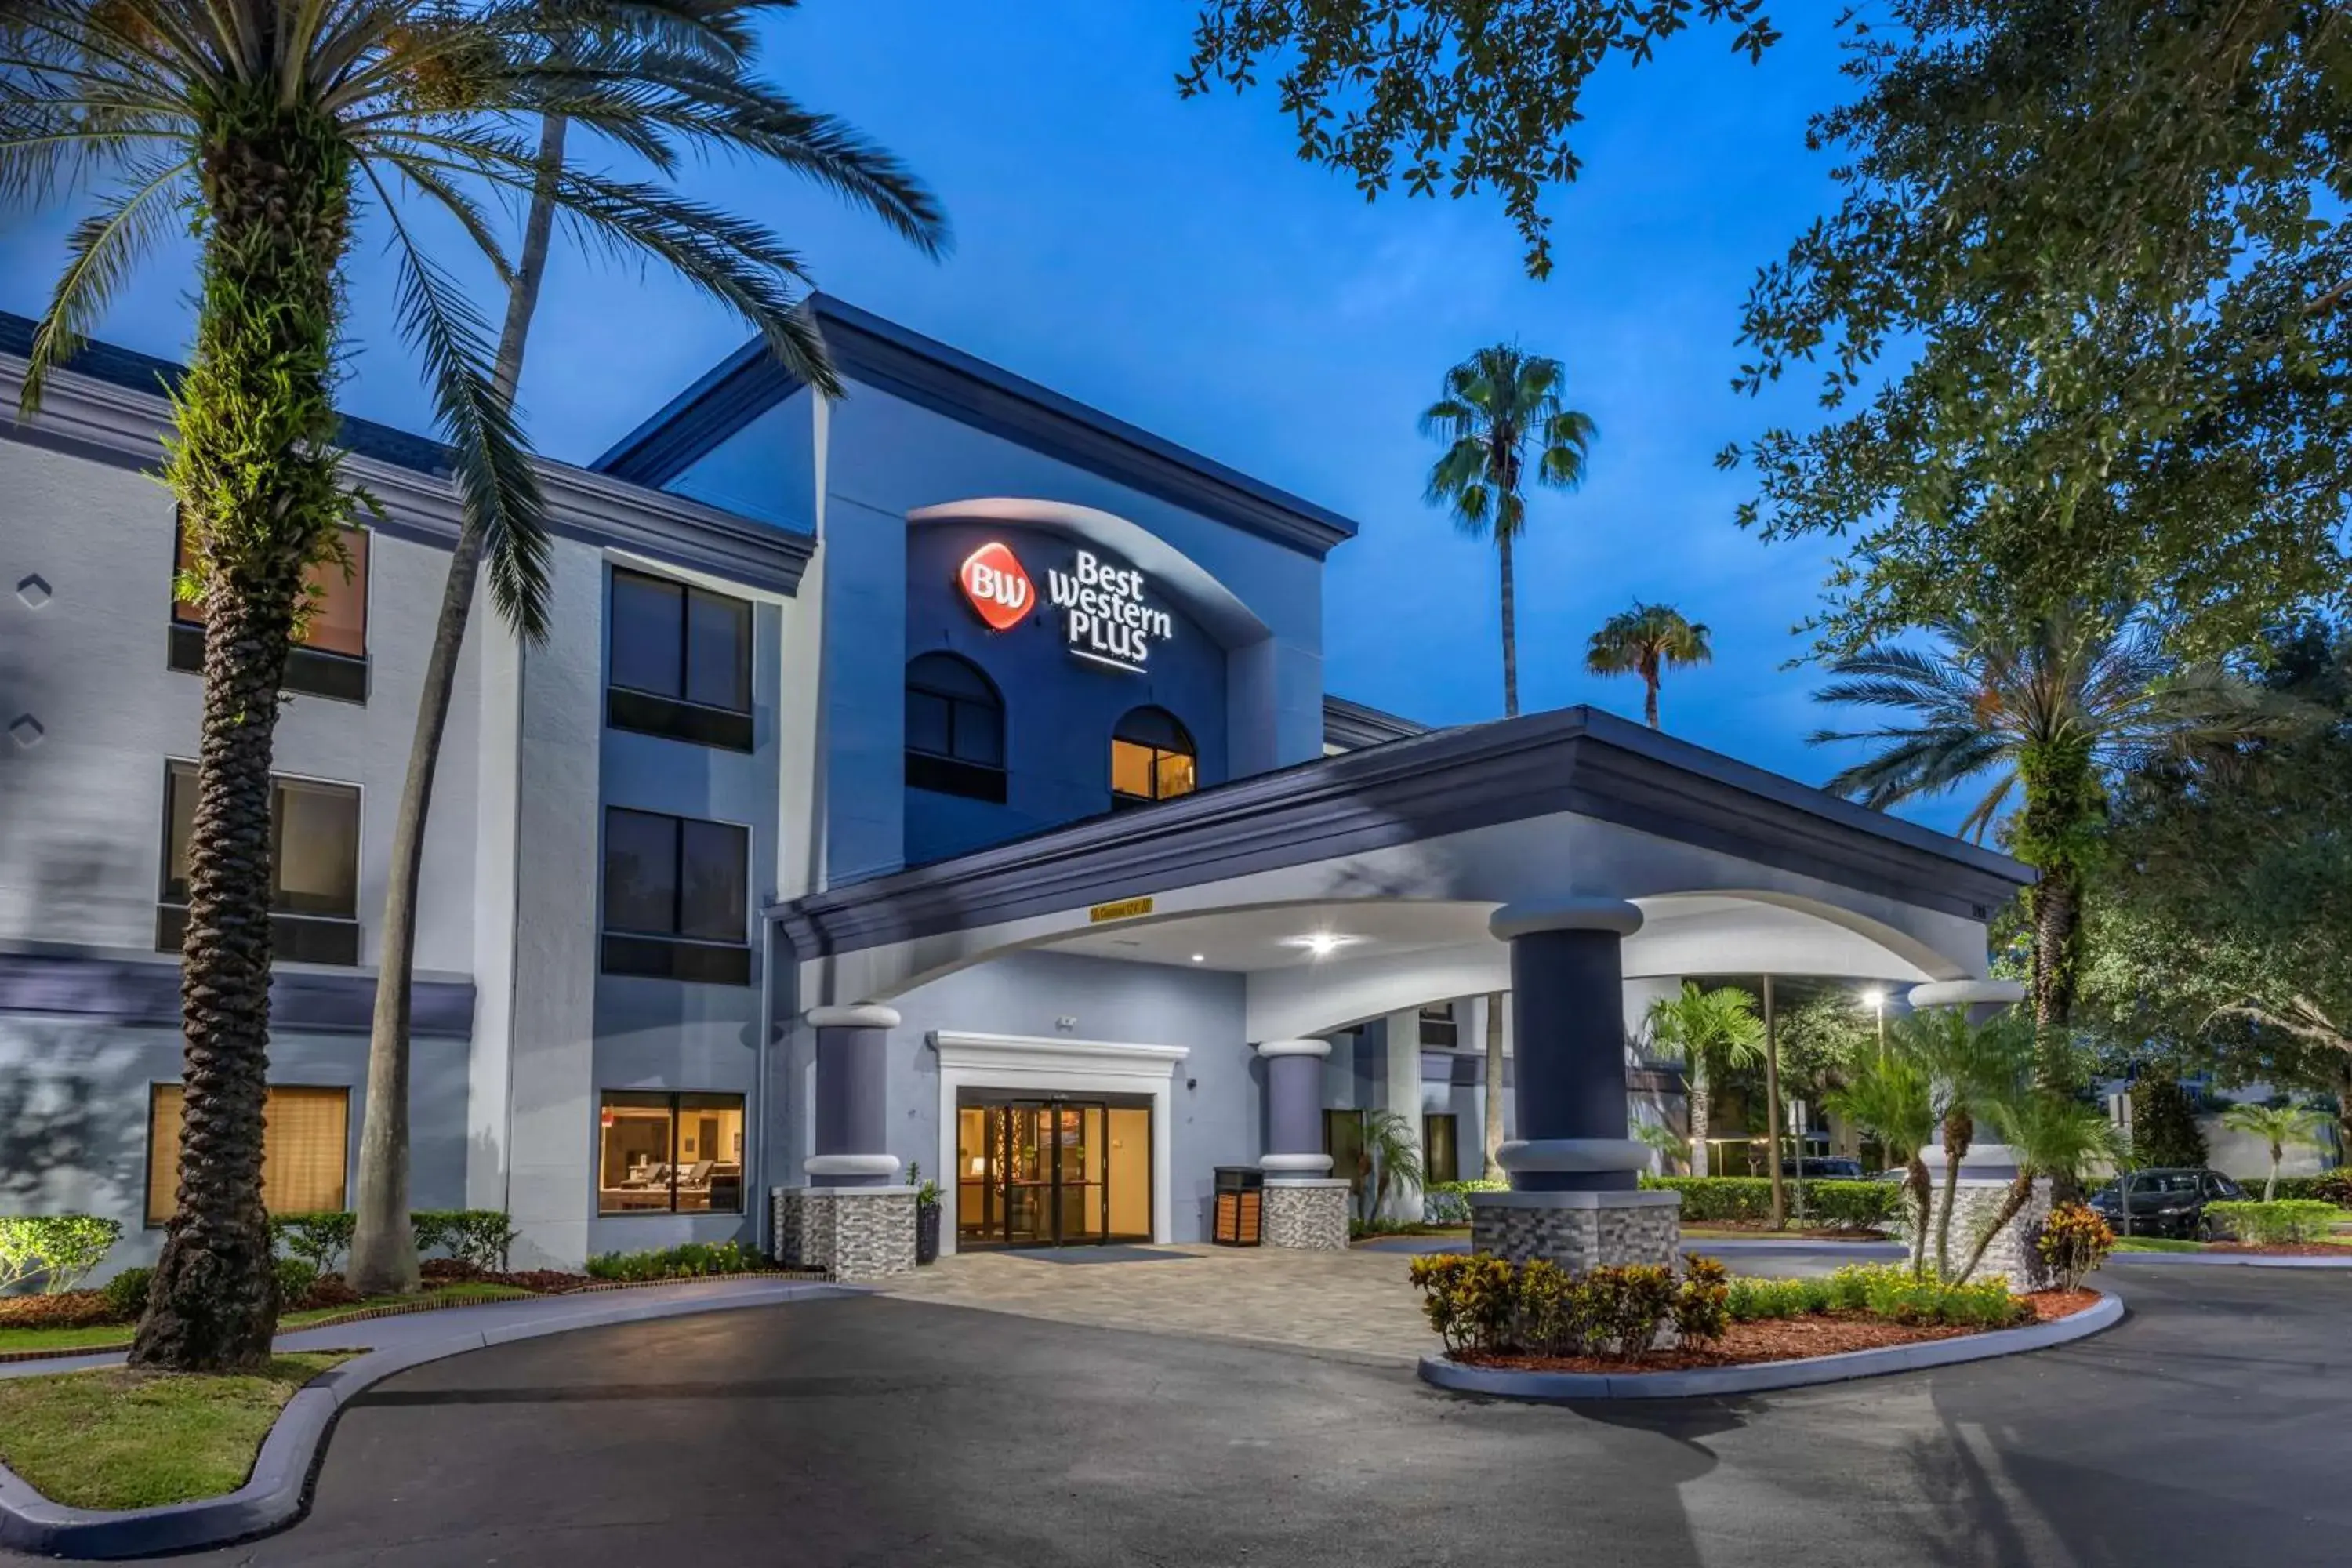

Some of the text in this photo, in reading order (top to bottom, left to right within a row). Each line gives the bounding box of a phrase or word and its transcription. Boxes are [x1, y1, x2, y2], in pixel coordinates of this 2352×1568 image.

[972, 562, 1026, 608] BW
[1077, 550, 1144, 601] Best
[1048, 568, 1172, 639] Western
[1069, 608, 1148, 661] PLUS
